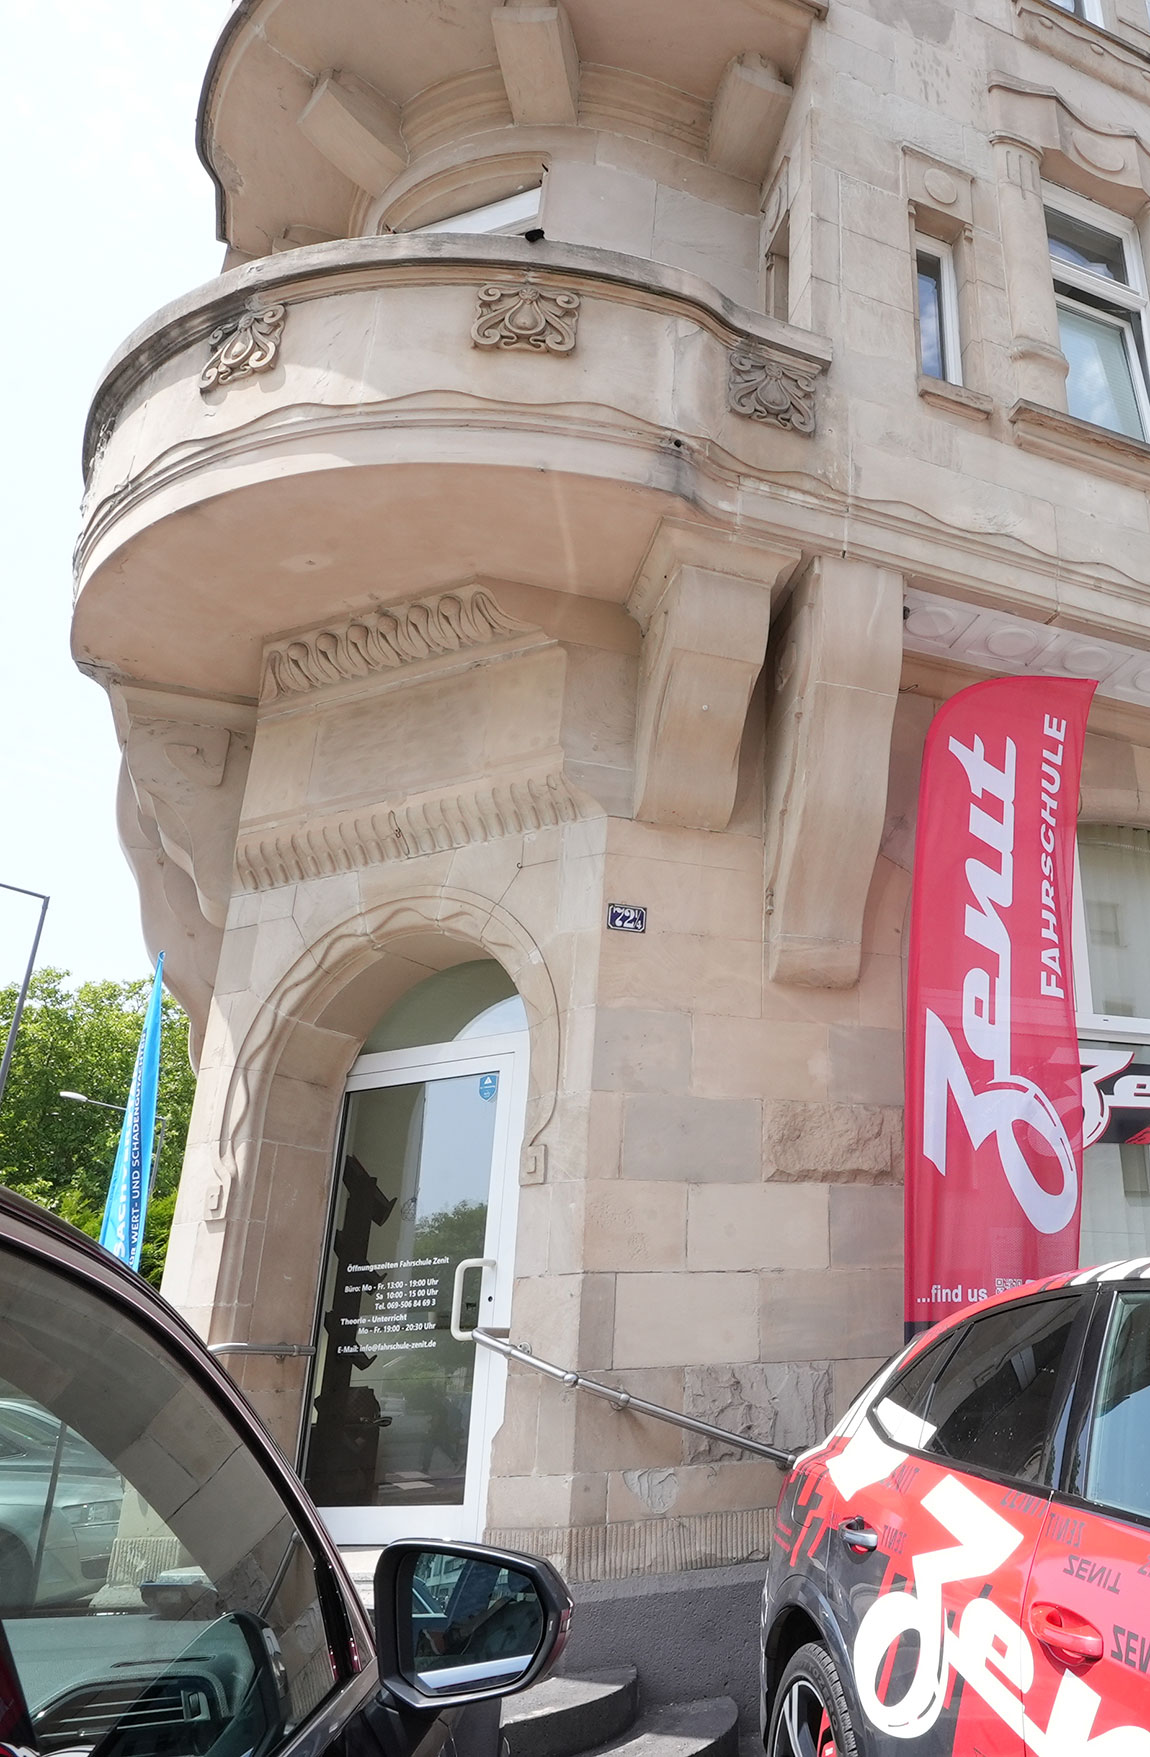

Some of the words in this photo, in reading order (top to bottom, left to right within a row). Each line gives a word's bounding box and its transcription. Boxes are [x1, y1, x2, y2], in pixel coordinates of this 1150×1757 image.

[1040, 713, 1067, 999] FAHRSCHULE
[923, 733, 1078, 1234] Zenit
[132, 1169, 140, 1199] UND
[131, 1202, 140, 1244] WERT-
[347, 1262, 398, 1272] Öffnungszeiten
[400, 1258, 432, 1268] Fahrschule
[432, 1256, 449, 1265] Zenit
[362, 1283, 372, 1292] Mo
[387, 1281, 403, 1289] 13:00
[409, 1279, 426, 1288] 19:00
[426, 1278, 439, 1286] Uhr
[376, 1293, 384, 1301] Sa
[386, 1291, 403, 1299] 10:00
[426, 1288, 439, 1296] Uhr
[968, 1289, 988, 1303] us
[375, 1302, 385, 1310] Tel.
[387, 1300, 412, 1309] 069-506
[413, 1299, 421, 1307] 84
[422, 1299, 431, 1307] 69
[431, 1298, 436, 1306] 3
[340, 1316, 367, 1326] Theorie
[372, 1313, 407, 1323] Unterricht
[373, 1326, 382, 1334] Fr.
[383, 1325, 400, 1333] 19:00
[405, 1323, 423, 1331] 20:30
[423, 1322, 436, 1330] Uhr
